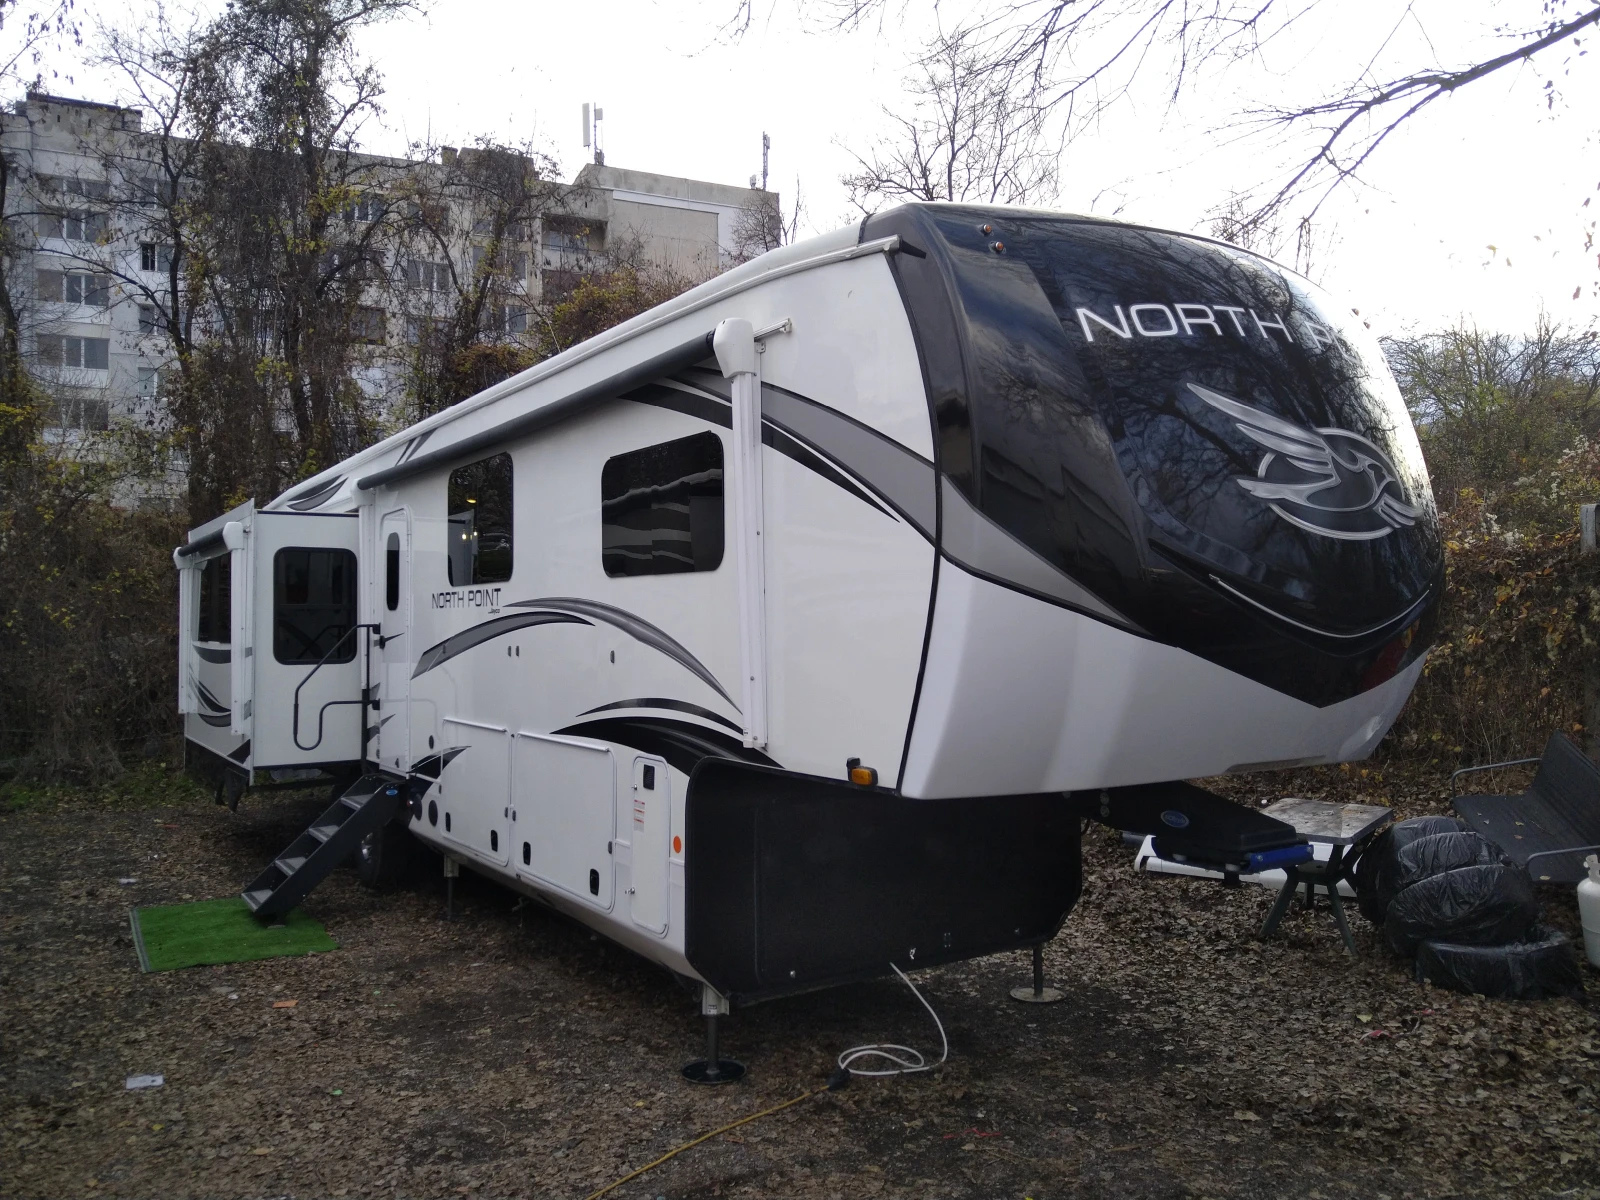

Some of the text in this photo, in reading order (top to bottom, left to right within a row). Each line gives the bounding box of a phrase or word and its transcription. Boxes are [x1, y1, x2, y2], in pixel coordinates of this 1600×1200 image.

[1076, 303, 1294, 343] NORTH
[431, 588, 501, 609] NORTH POINT
